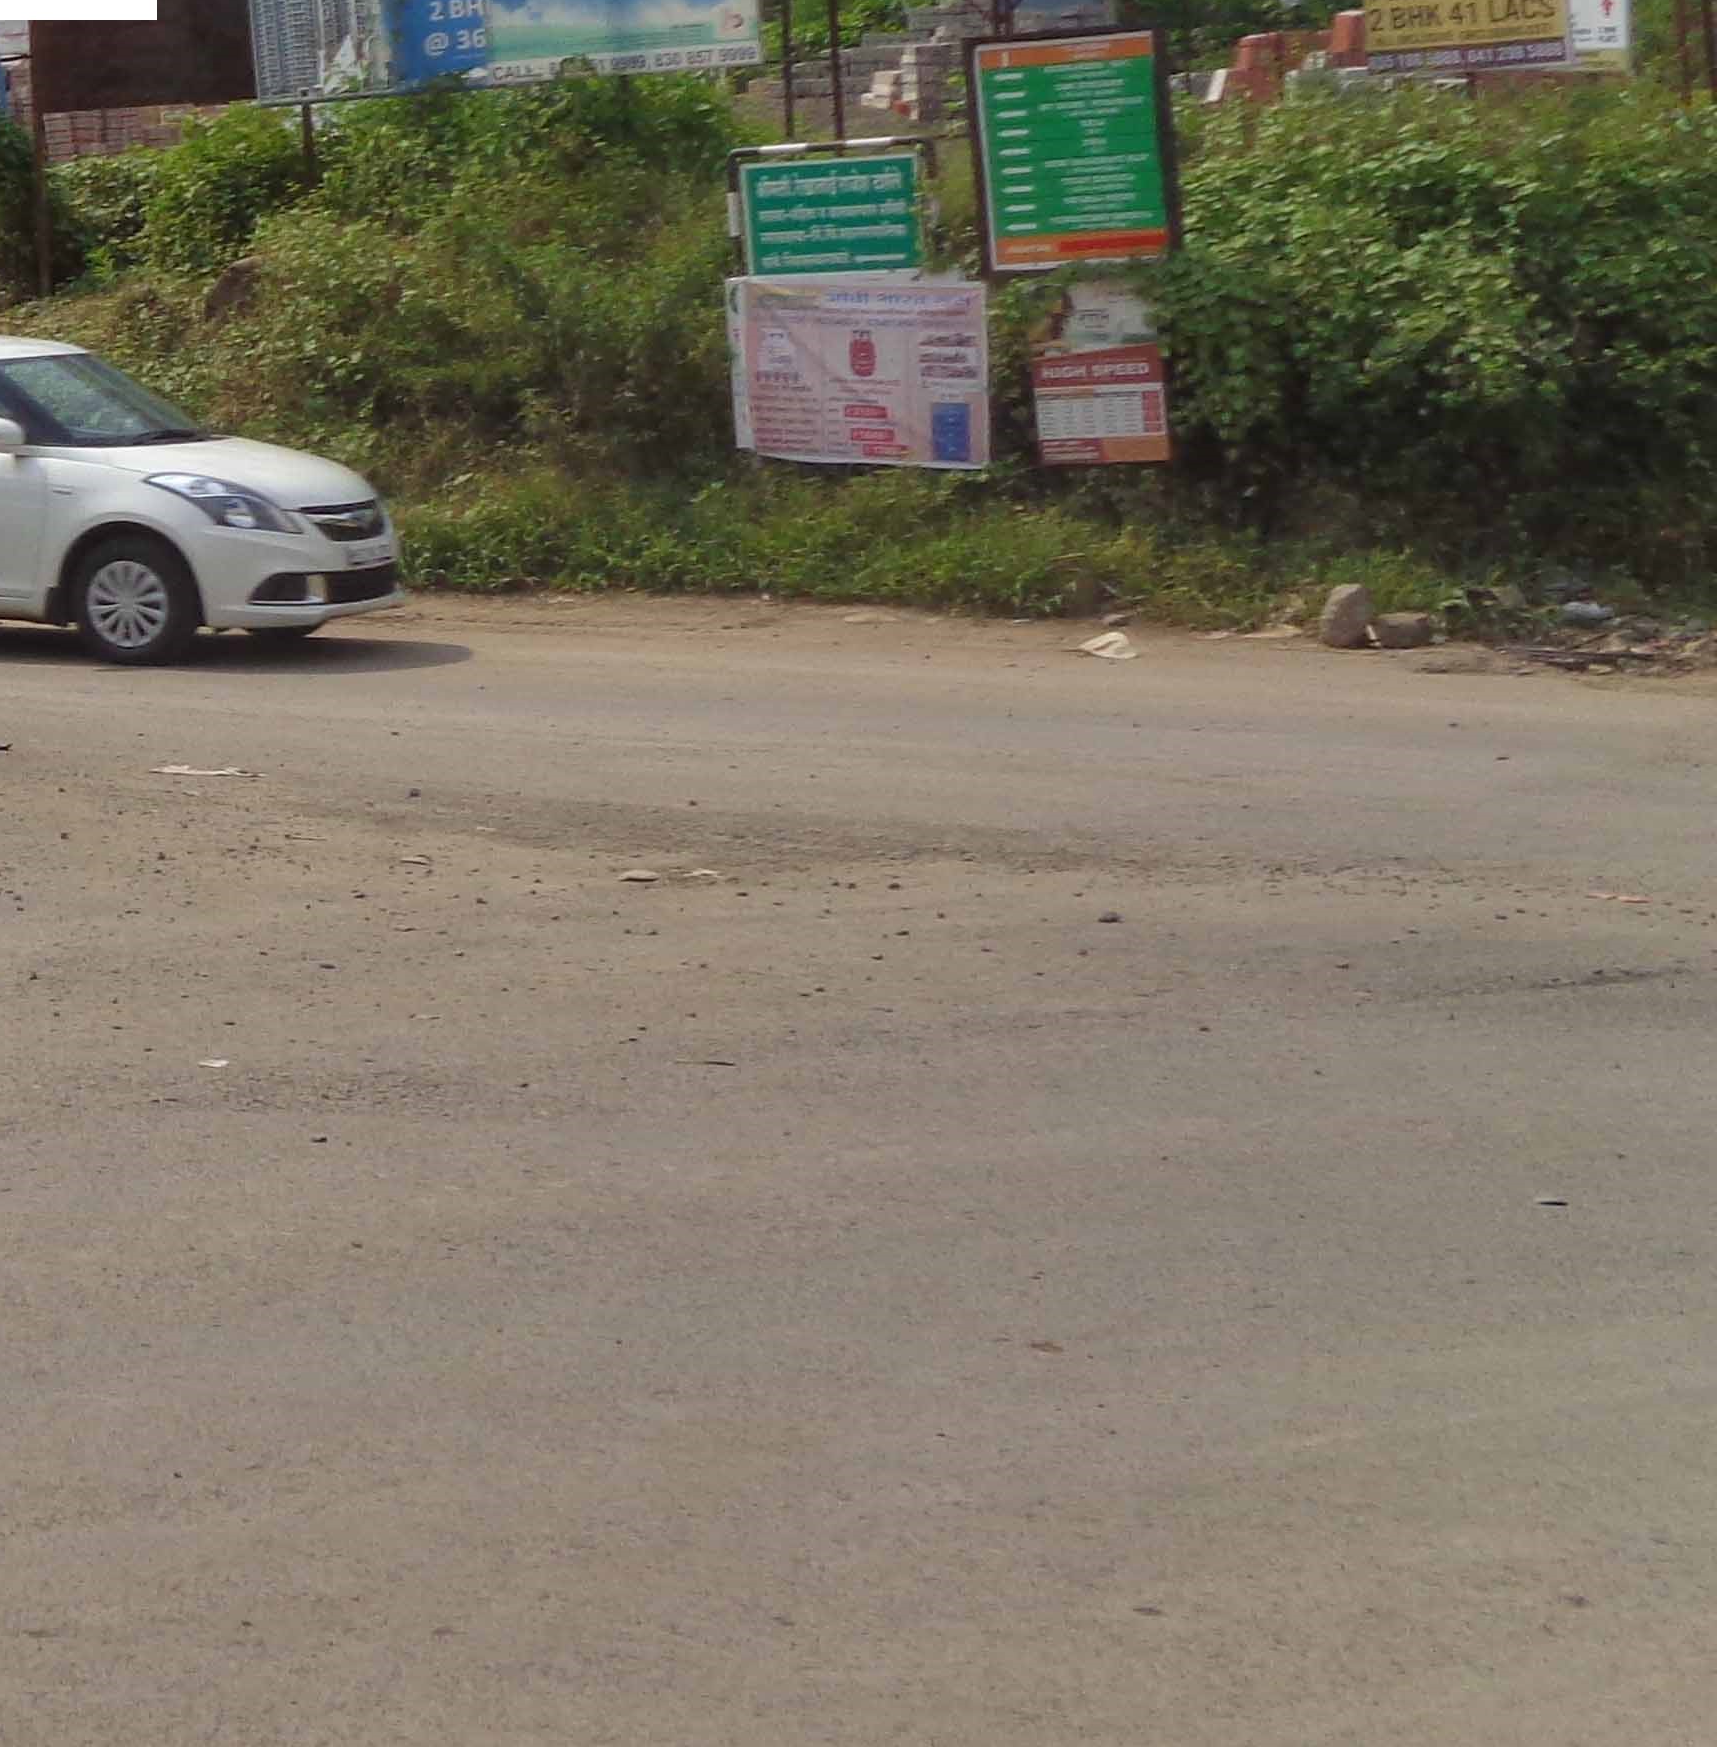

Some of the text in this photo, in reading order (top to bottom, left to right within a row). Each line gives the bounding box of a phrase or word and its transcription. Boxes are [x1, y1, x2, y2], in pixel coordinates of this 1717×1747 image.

[429, 0, 446, 21] 2
[1369, 8, 1384, 32] 2
[1392, 3, 1442, 29] BHK
[1449, 1, 1479, 26] 41
[455, 28, 486, 51] 36
